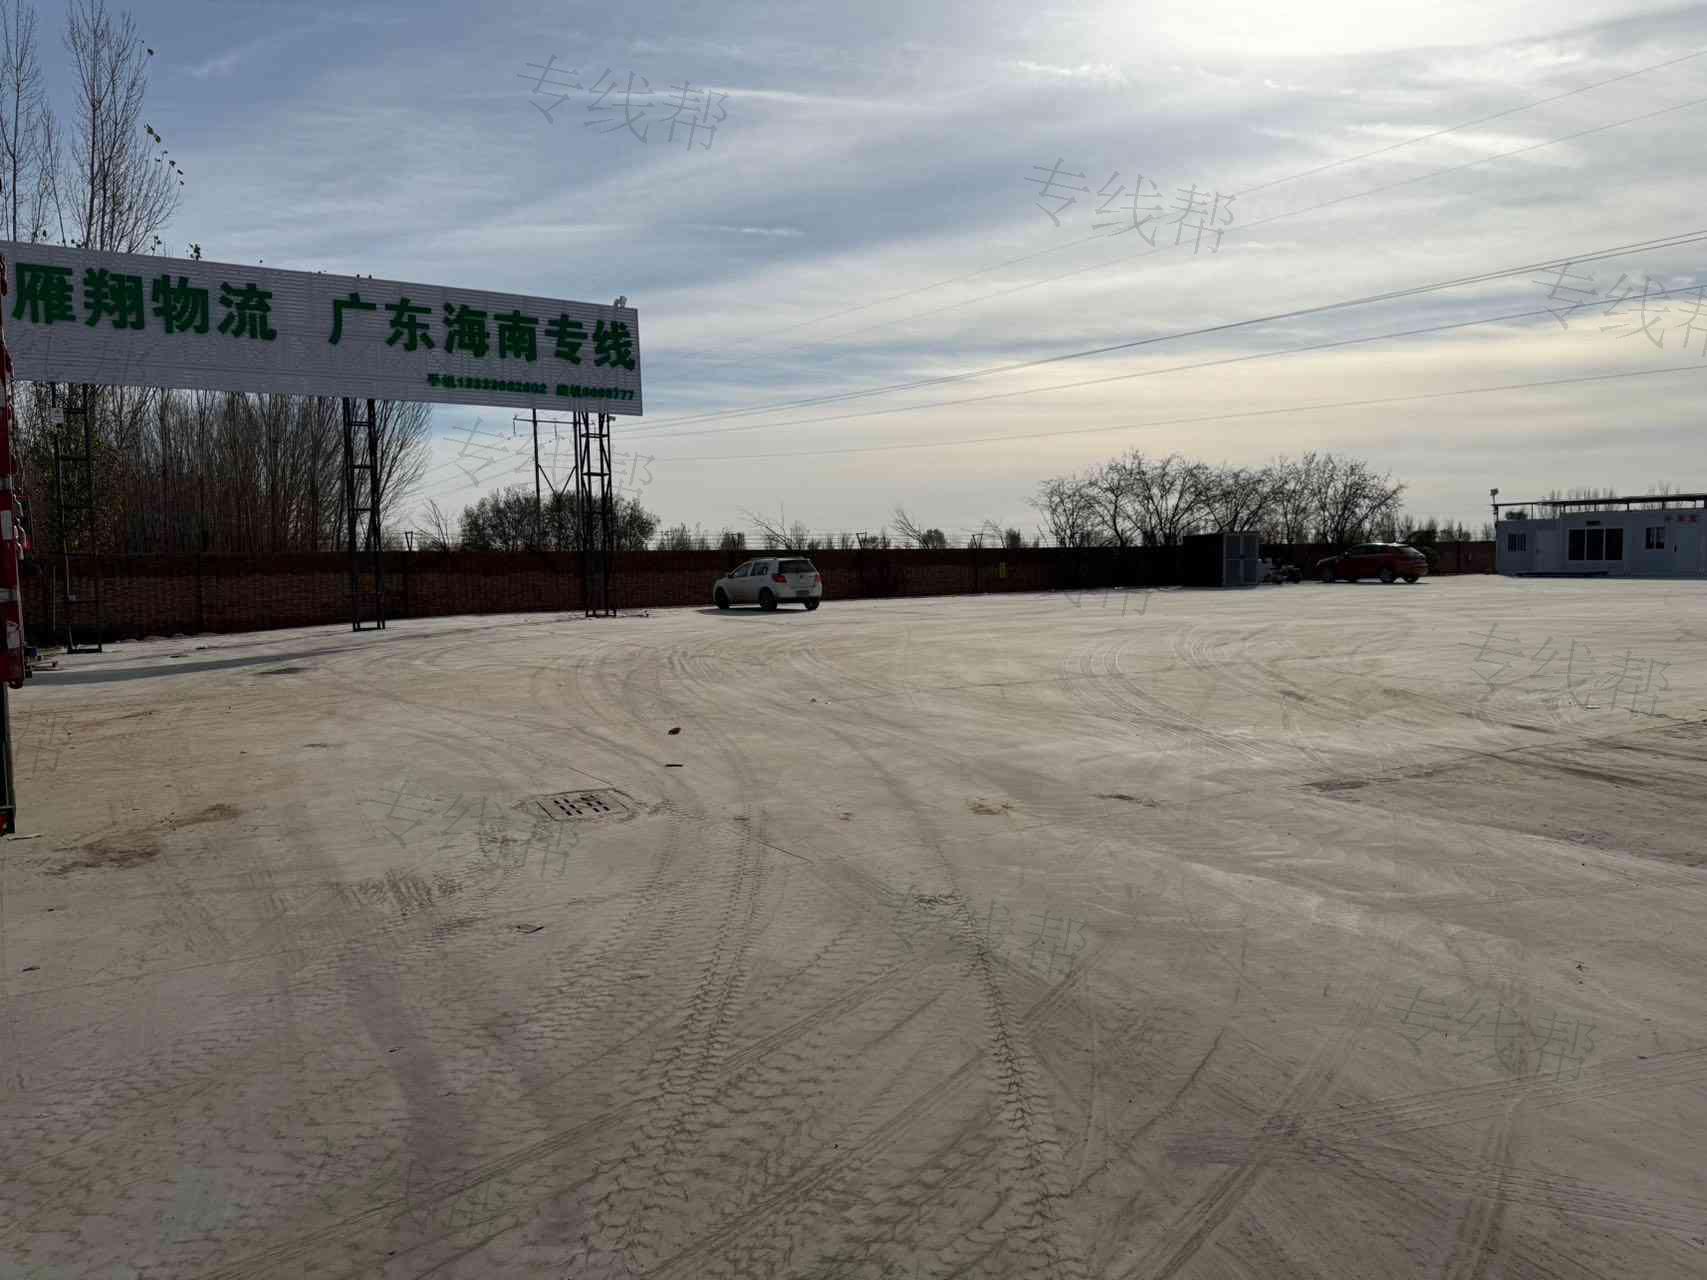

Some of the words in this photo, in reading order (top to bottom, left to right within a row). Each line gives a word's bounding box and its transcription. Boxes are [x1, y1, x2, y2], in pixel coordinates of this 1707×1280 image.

[11, 261, 277, 341] 雁翔物流
[328, 292, 636, 370] 广东海南专线
